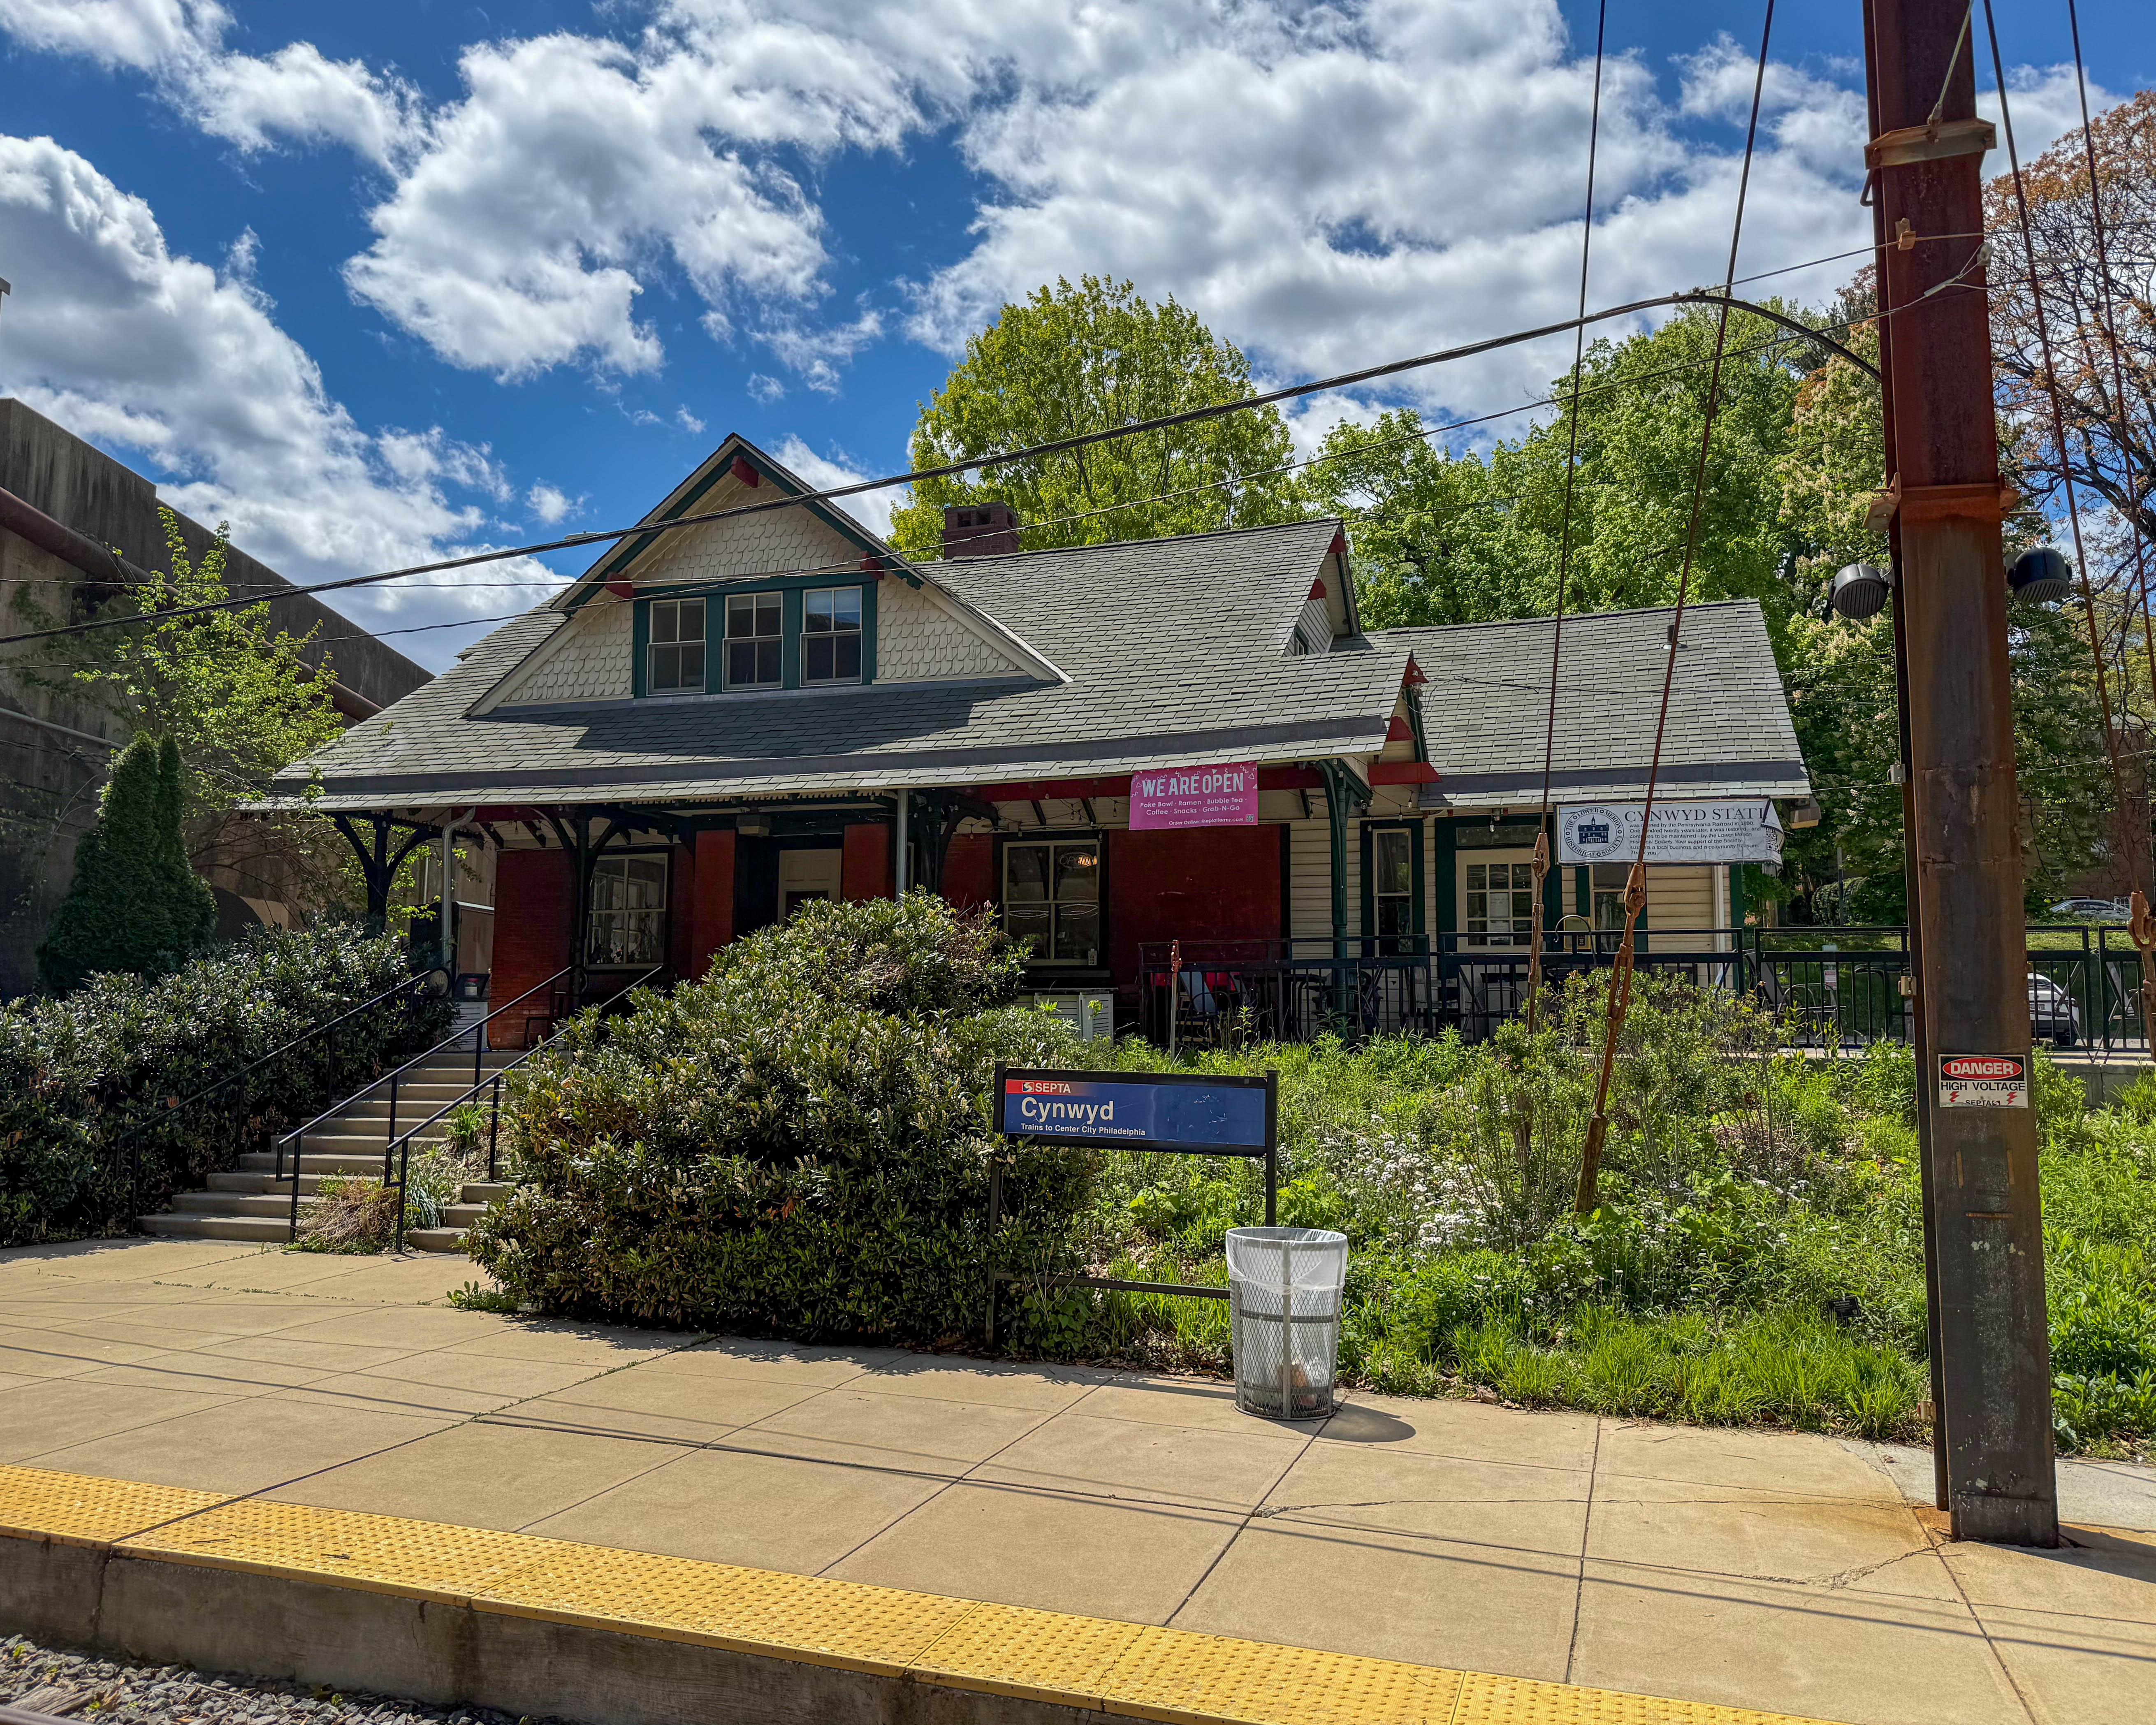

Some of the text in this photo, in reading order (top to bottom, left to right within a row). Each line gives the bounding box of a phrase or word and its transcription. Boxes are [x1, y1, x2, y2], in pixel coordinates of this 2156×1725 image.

[1142, 772, 1244, 798] WE ARE OPEN
[1625, 807, 1764, 822] CYNWYD STATI
[1950, 1062, 2014, 1074] DANGER
[1035, 1083, 1071, 1093] SEPTA
[1941, 1082, 2026, 1091] HIGH VOLTAGE
[1021, 1097, 1114, 1124] Cynwyd
[1082, 1126, 1097, 1135] City
[1099, 1126, 1146, 1136] Philadelphia
